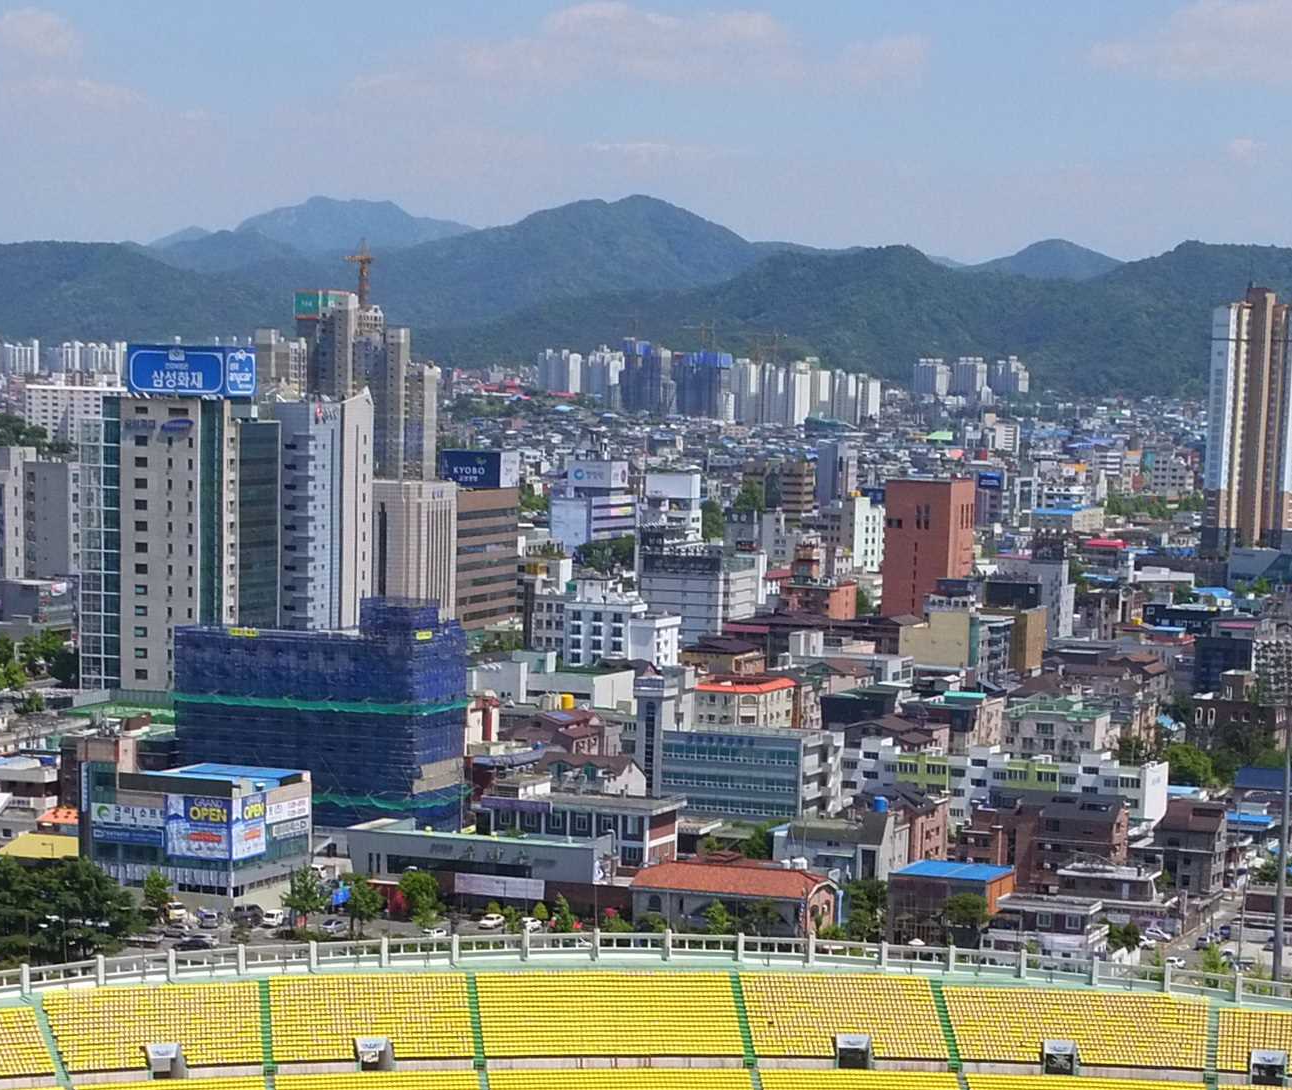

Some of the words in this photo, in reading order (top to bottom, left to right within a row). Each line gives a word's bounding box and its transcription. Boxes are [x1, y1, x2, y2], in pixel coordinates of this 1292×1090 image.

[151, 370, 204, 389] 삼성화재
[453, 466, 485, 475] KYOBO
[193, 797, 224, 808] GRAND
[189, 806, 228, 823] OPEN
[243, 803, 265, 820] OPEN
